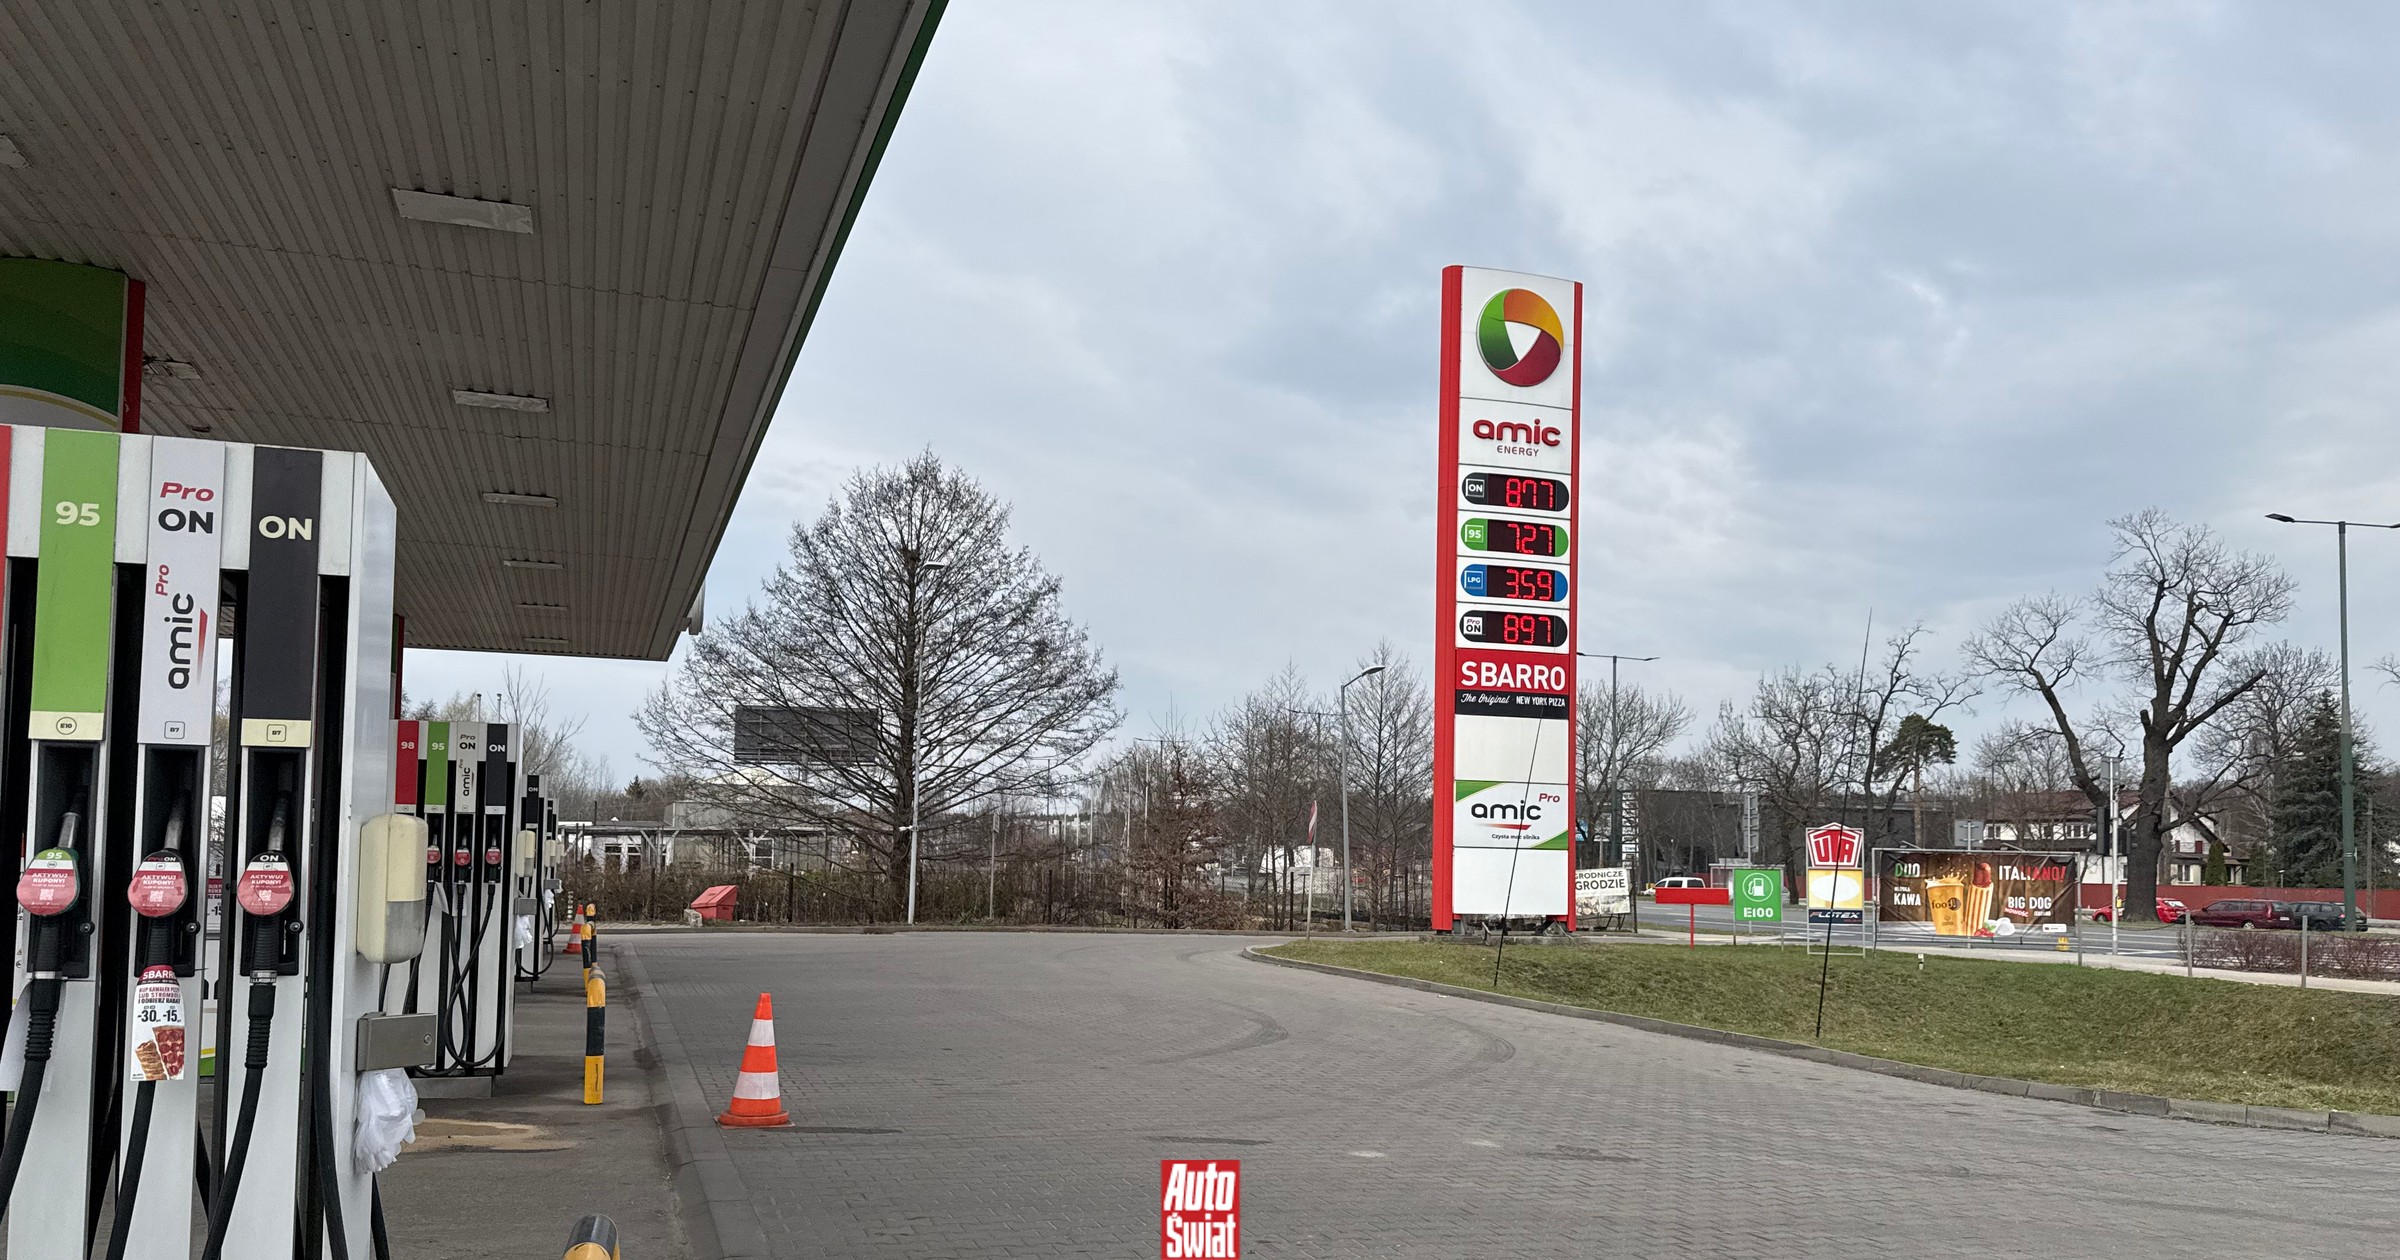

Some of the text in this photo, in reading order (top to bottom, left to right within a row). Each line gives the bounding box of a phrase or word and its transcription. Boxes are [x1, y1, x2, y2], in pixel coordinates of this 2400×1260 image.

[1473, 419, 1560, 446] amic
[1496, 445, 1539, 457] ENERGY
[160, 482, 214, 501] Pro
[1468, 484, 1483, 492] ON
[55, 501, 100, 526] 95
[158, 508, 214, 534] ON
[258, 515, 312, 541] ON
[1468, 529, 1481, 538] 95
[155, 564, 170, 596] Pro
[164, 592, 194, 690] amic
[1461, 661, 1566, 691] SBARRO
[1461, 693, 1565, 706] The Original NEW YORK PIZZA
[401, 741, 415, 750] 98
[432, 742, 445, 750] 95
[460, 742, 475, 750] ON
[489, 744, 506, 752] ON
[462, 767, 470, 796] amic
[1539, 793, 1560, 803] Pro
[1471, 800, 1541, 820] amic
[1895, 863, 2066, 883] DUO ITALIANO!
[1894, 893, 1921, 906] KAWA
[2008, 896, 2052, 909] BIG DOG
[1744, 907, 1774, 918] E100
[143, 970, 177, 979] SBARR
